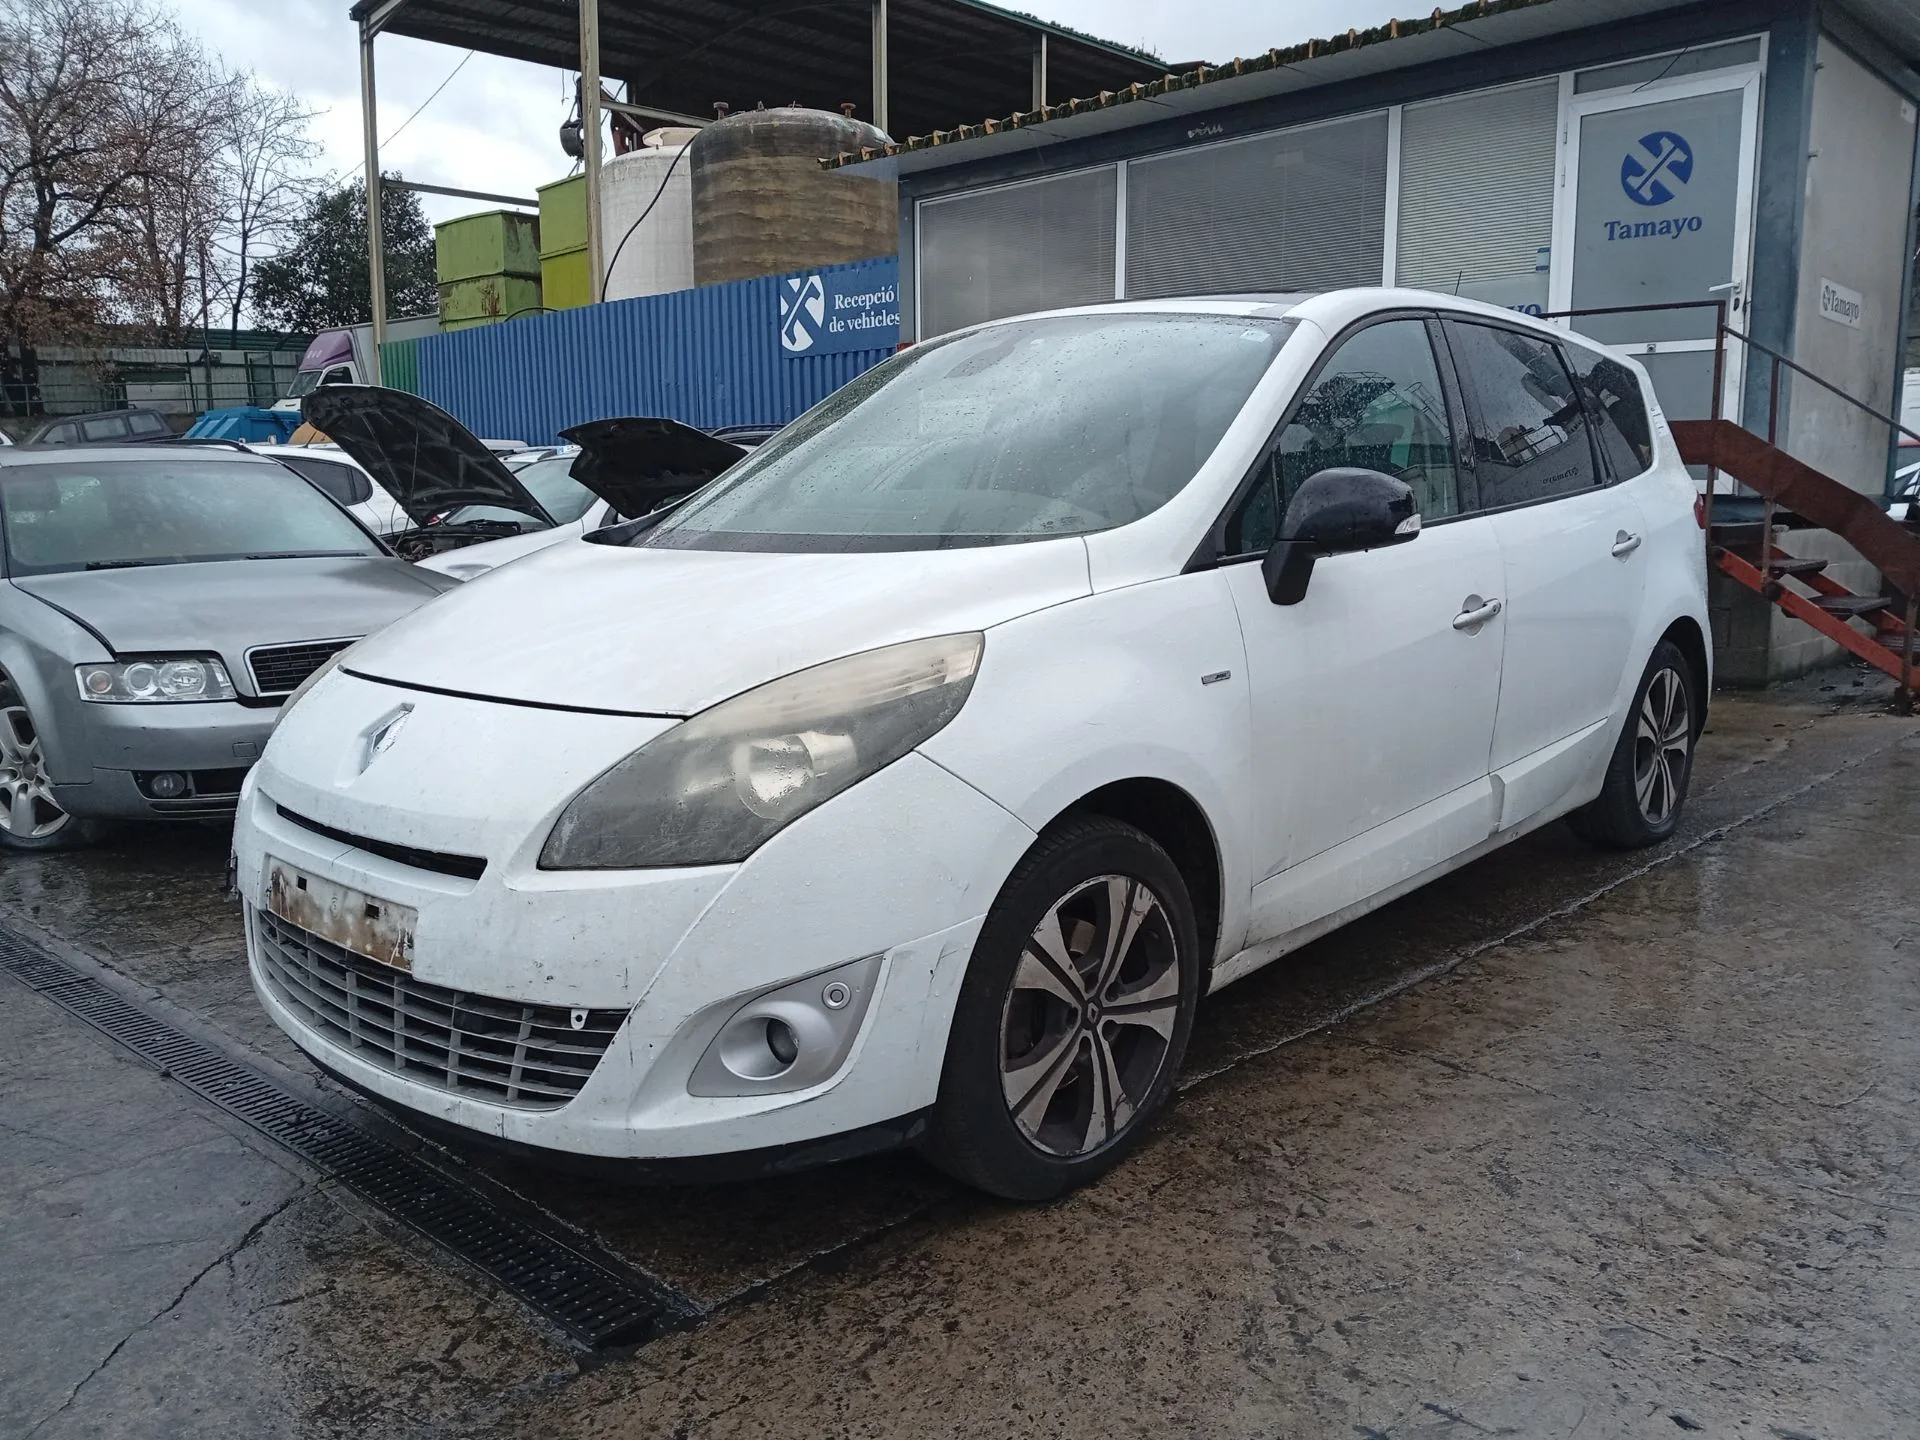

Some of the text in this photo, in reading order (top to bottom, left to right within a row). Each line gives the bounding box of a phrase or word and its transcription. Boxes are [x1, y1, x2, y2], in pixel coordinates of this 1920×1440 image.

[1604, 216, 1702, 241] Tamayo
[834, 285, 895, 310] Recepció
[1831, 289, 1860, 324] Tamayo
[829, 310, 900, 333] de vehicles
